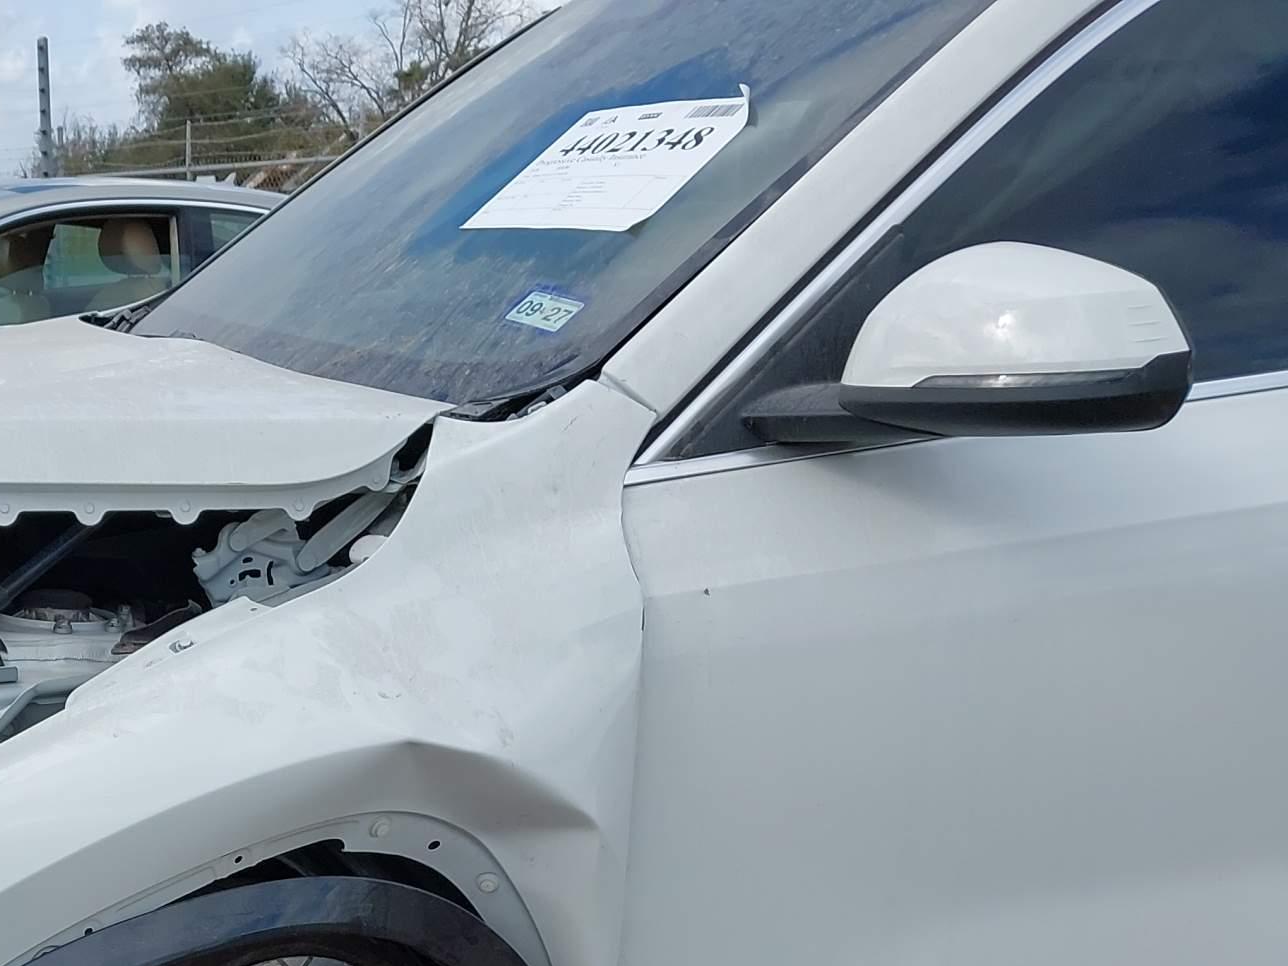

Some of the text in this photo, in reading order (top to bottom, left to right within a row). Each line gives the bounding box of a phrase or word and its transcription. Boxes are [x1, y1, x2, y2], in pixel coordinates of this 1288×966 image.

[560, 126, 715, 157] 44021348
[516, 300, 574, 324] 09 27
